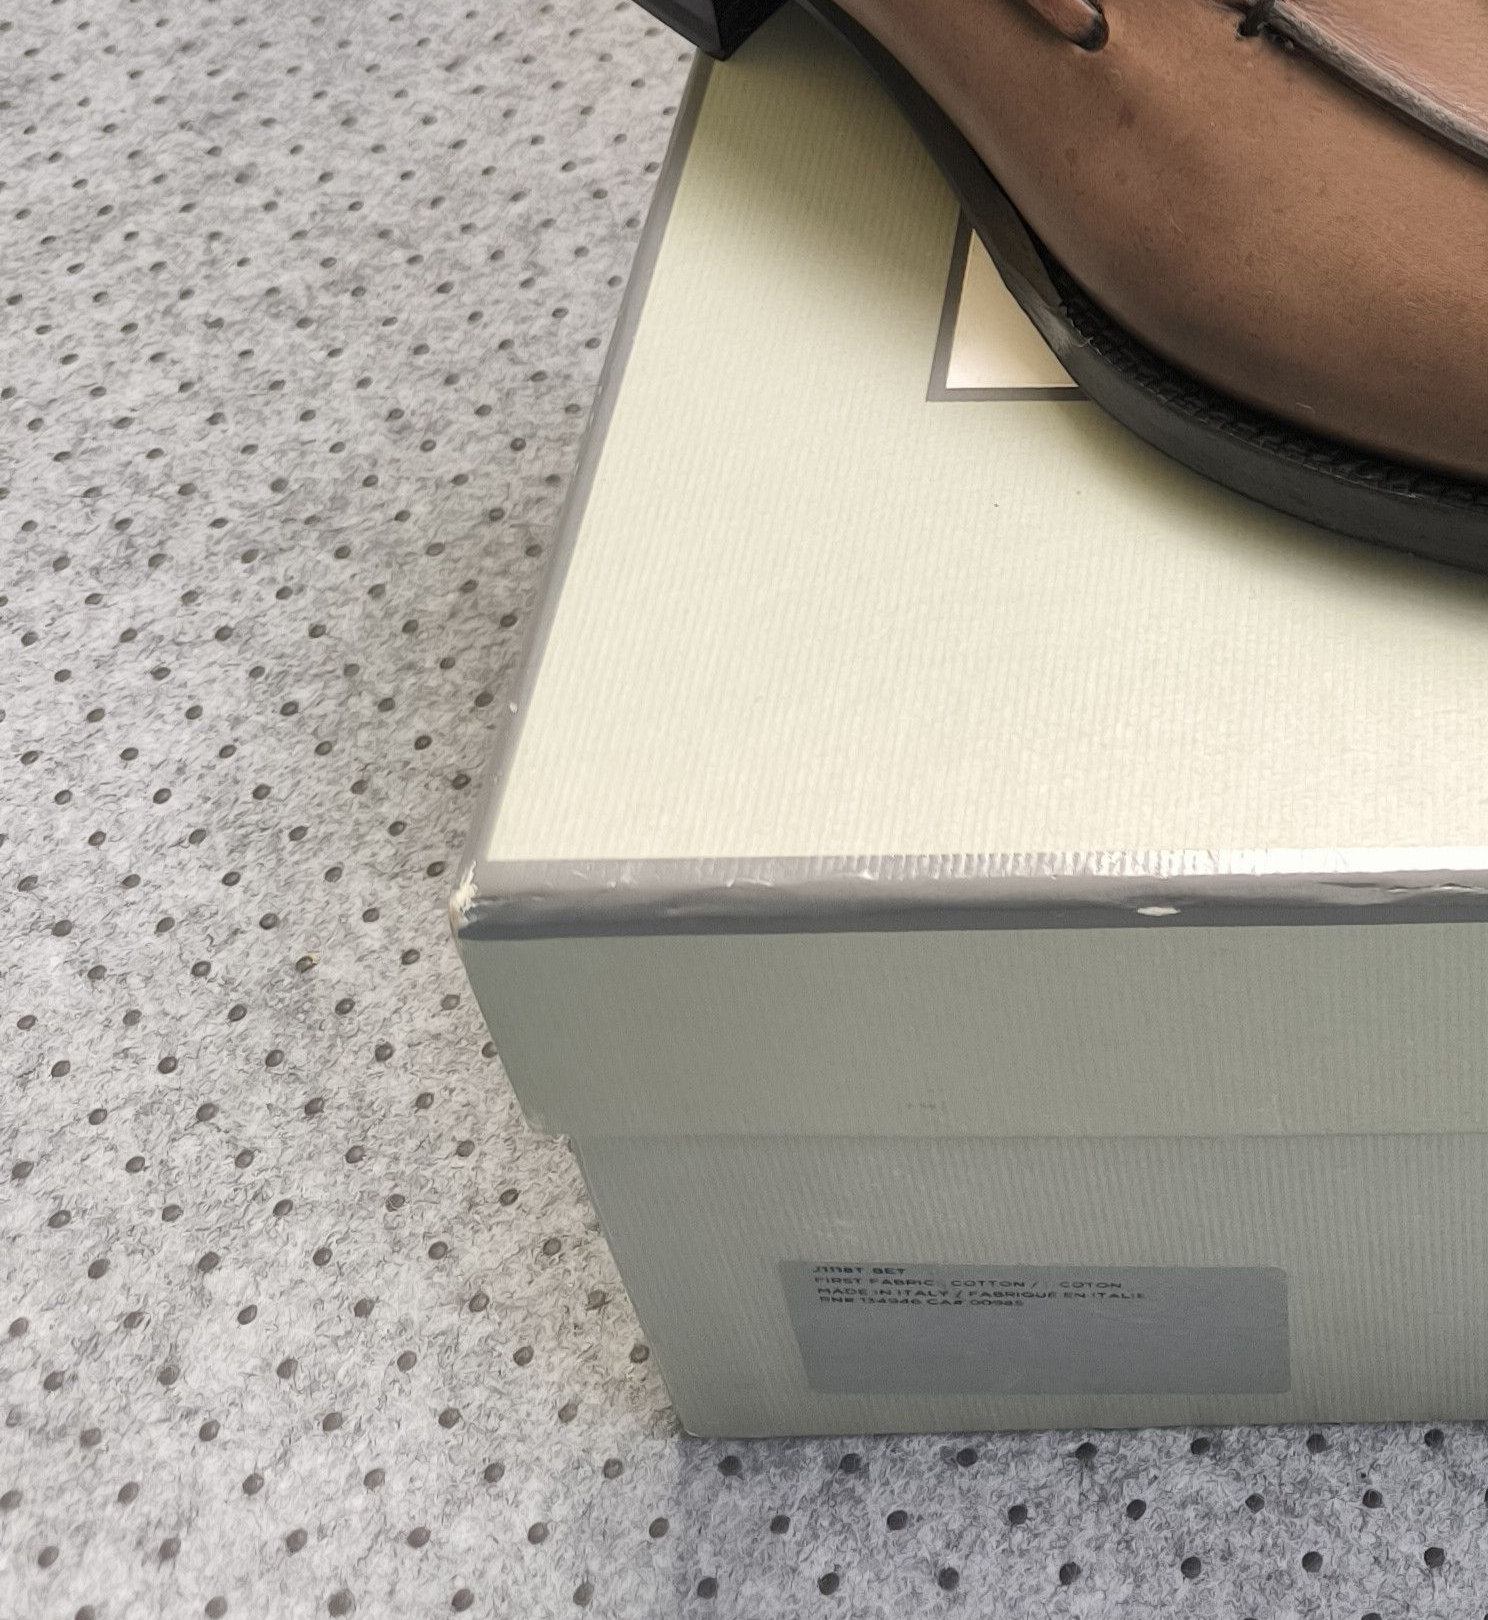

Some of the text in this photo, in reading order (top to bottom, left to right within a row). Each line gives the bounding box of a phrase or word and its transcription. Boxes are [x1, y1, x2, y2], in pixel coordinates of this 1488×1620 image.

[951, 1280, 1025, 1288] COTTON
[1059, 1281, 1122, 1289] COTON
[898, 1289, 949, 1297] ITALY
[969, 1291, 1056, 1299] FABRIQUE
[1092, 1292, 1146, 1300] ITALIE
